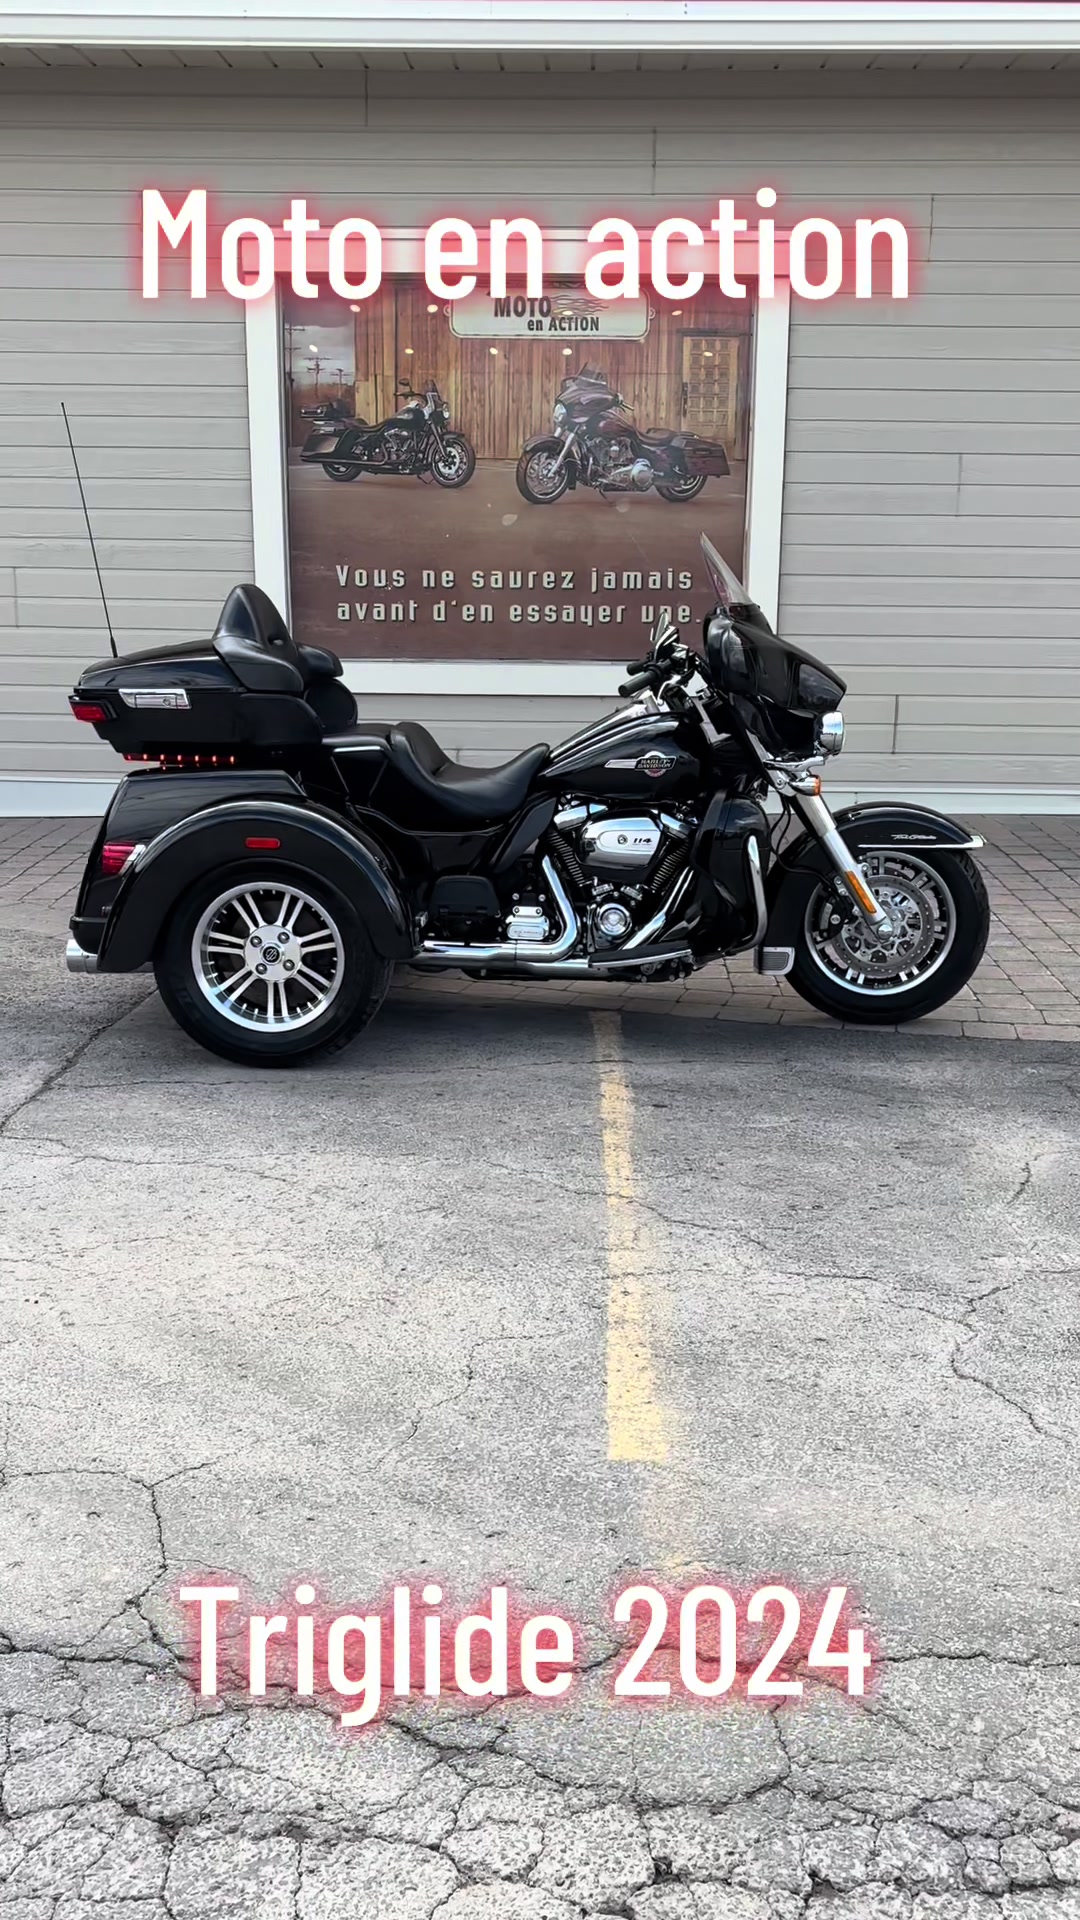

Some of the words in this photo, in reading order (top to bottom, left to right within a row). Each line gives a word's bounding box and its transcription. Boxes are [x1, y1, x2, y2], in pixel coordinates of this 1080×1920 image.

[494, 296, 552, 318] MOTO
[527, 319, 544, 332] en
[549, 317, 600, 332] ACTION
[336, 565, 406, 588] Vous
[422, 570, 455, 588] ne
[471, 570, 575, 589] saurez
[591, 568, 693, 593] jamais
[337, 600, 419, 622] avant
[433, 600, 494, 622] d'en
[509, 604, 626, 626] essayer
